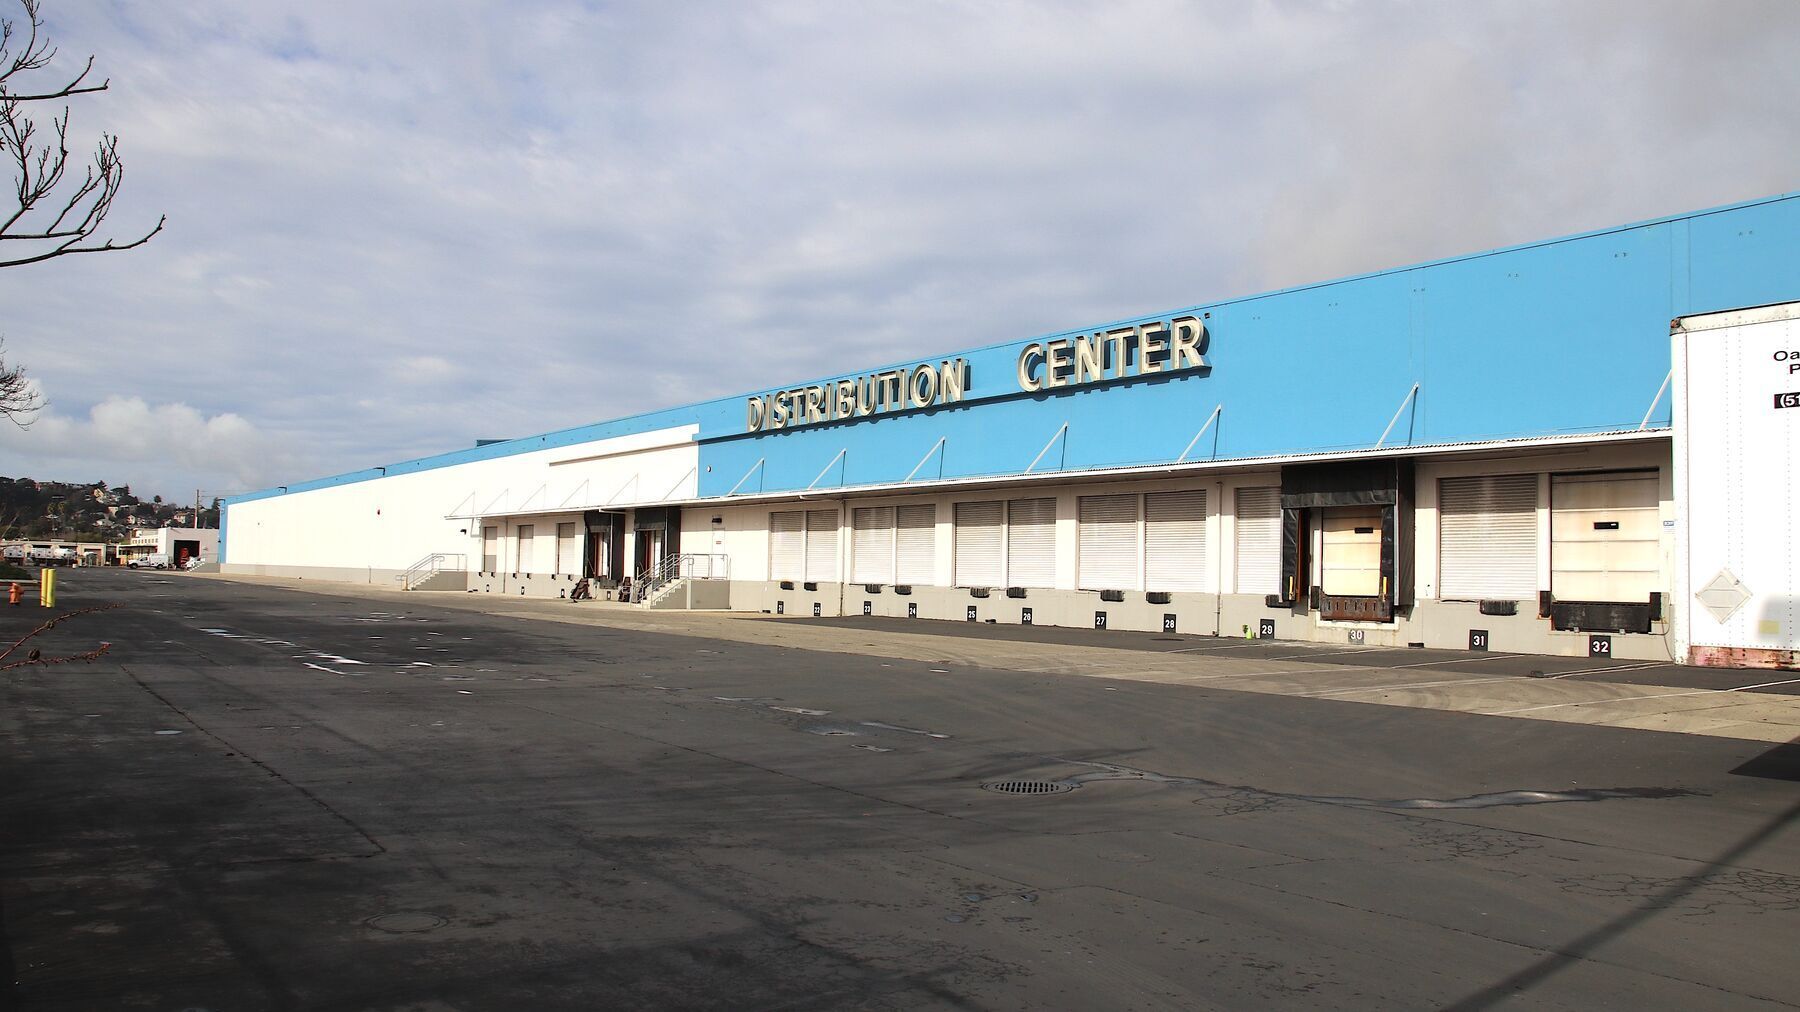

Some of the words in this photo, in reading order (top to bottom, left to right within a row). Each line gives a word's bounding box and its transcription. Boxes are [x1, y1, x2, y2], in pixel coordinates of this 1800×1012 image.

[747, 357, 965, 432] DISTRIBUTION
[1017, 315, 1206, 392] CENTER
[909, 607, 916, 615] 24
[968, 610, 976, 619] 25
[1096, 616, 1105, 626] 27
[1165, 619, 1175, 629] 28
[1261, 624, 1273, 635] 29
[1350, 630, 1363, 640] 30
[1473, 635, 1485, 646] 31
[1592, 641, 1609, 653] 32
